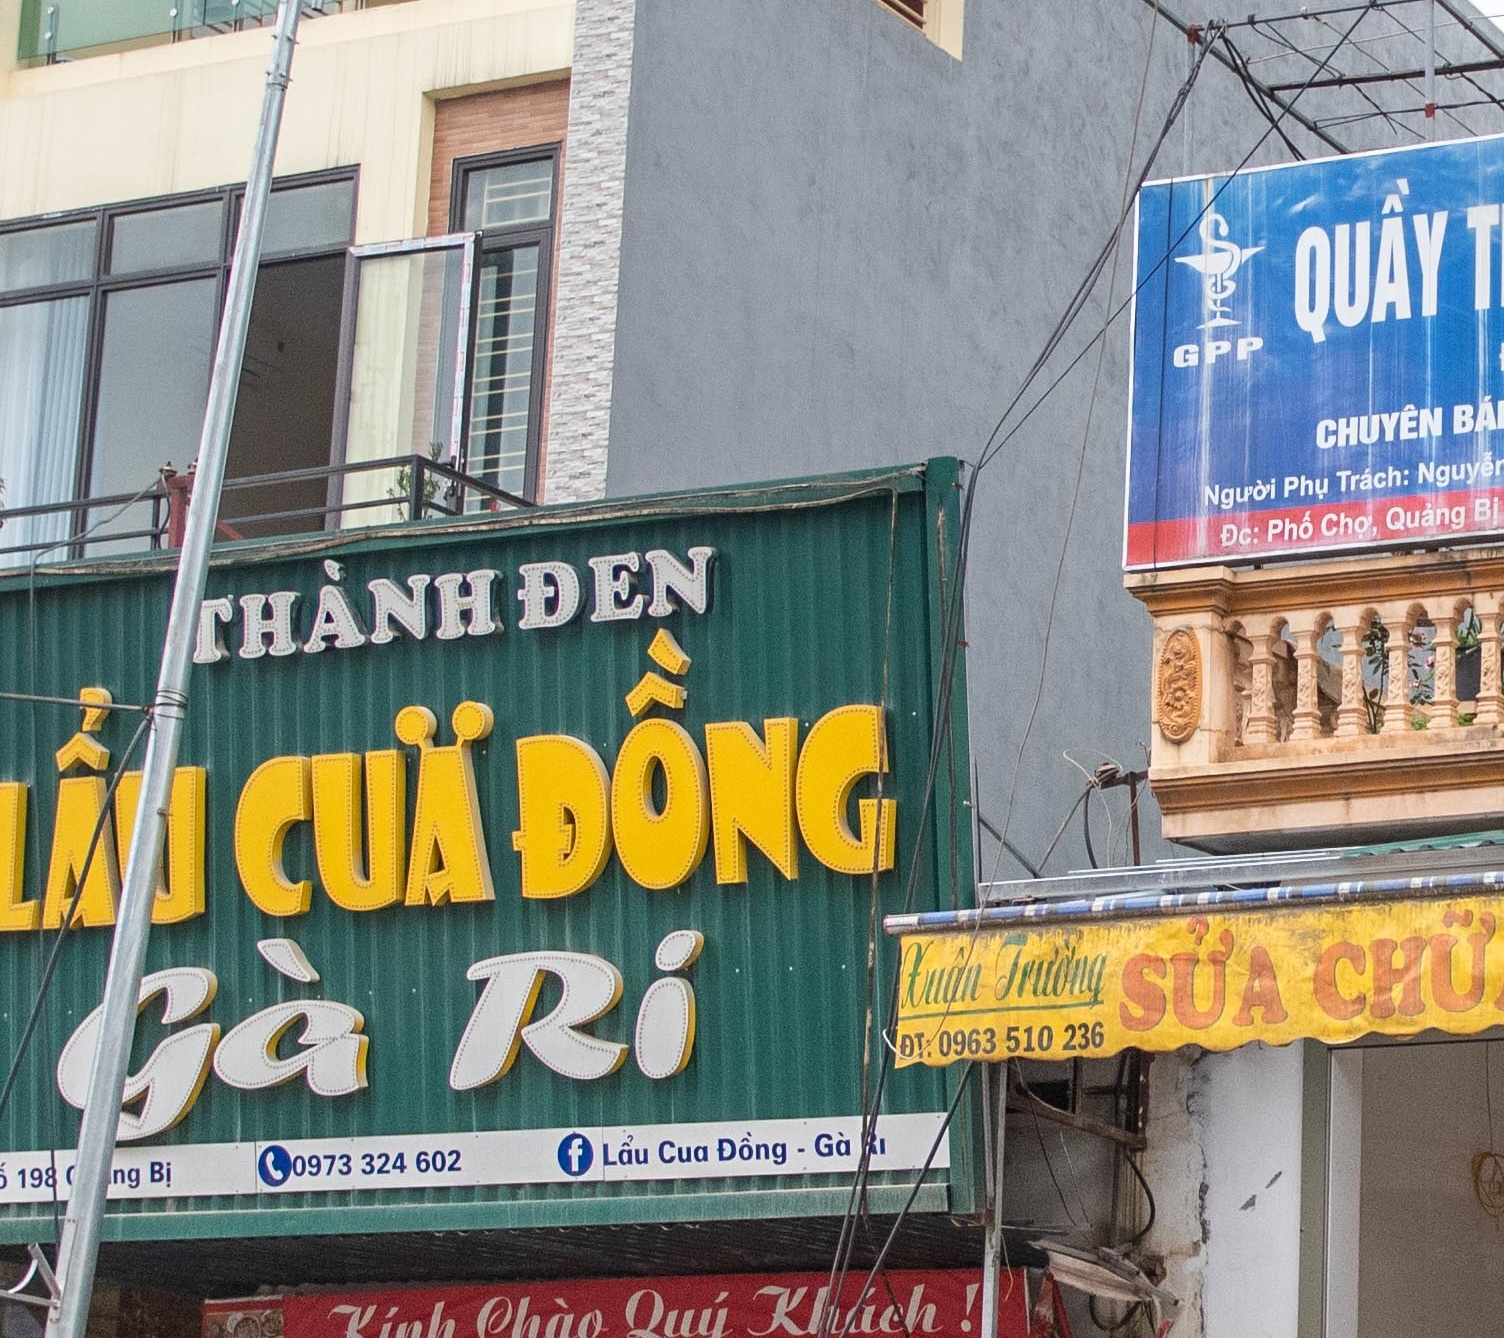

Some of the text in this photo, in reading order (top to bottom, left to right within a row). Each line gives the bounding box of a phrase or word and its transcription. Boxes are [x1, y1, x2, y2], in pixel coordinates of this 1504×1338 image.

[1293, 178, 1450, 344] QUẦY
[1173, 335, 1265, 369] GPP
[1316, 404, 1442, 449] CHUYÊN
[1205, 483, 1276, 512] Người
[1284, 475, 1329, 505] Phụ
[1336, 465, 1410, 492] Trách:
[1220, 522, 1259, 548] Đc:
[1267, 513, 1313, 544] Phố
[1320, 509, 1378, 541] Chợ,
[1385, 497, 1466, 534] Quảng
[1474, 495, 1498, 525] Bị
[193, 546, 717, 664] THÀNH ĐEN
[512, 629, 897, 898] ĐỒNG
[900, 941, 983, 1010] Xuân
[1118, 915, 1289, 1032] SỬA
[54, 937, 370, 1142] Gà
[938, 1027, 997, 1057] 0963
[1005, 1024, 1054, 1054] 510
[1063, 1021, 1105, 1051] 236
[17, 1167, 57, 1190] 198
[150, 1160, 173, 1189] Bị
[291, 1154, 353, 1178] 0973
[361, 1152, 408, 1176] 324
[416, 1147, 462, 1173] 602
[603, 1133, 649, 1168] Lẩu
[658, 1139, 709, 1164] Cua
[717, 1130, 788, 1166] Đồng
[814, 1129, 851, 1158] Gà
[747, 1282, 944, 1337] Khách
